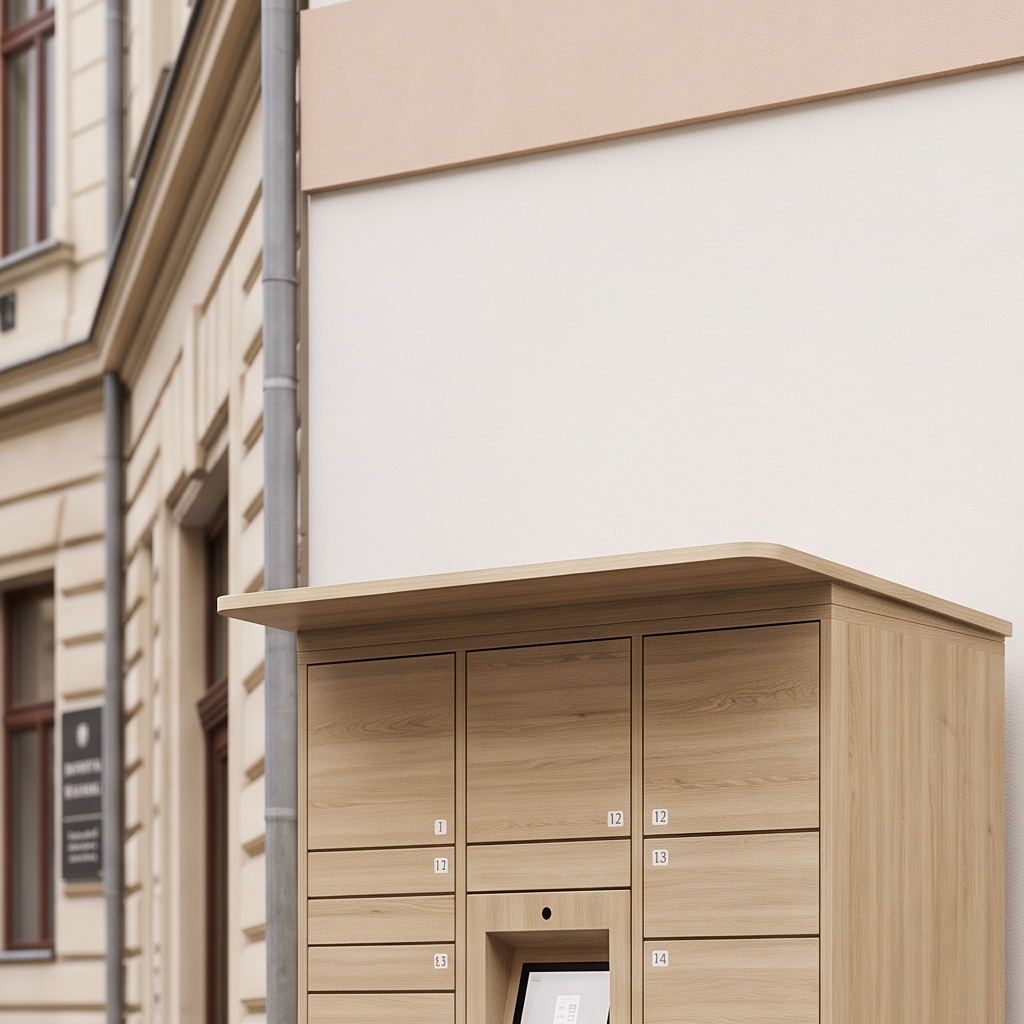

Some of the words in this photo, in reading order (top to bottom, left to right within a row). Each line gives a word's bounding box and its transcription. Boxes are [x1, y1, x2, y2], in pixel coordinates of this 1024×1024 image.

[610, 812, 622, 825] 12
[654, 810, 667, 823] 12
[654, 851, 667, 864] 13
[654, 952, 667, 965] 14
